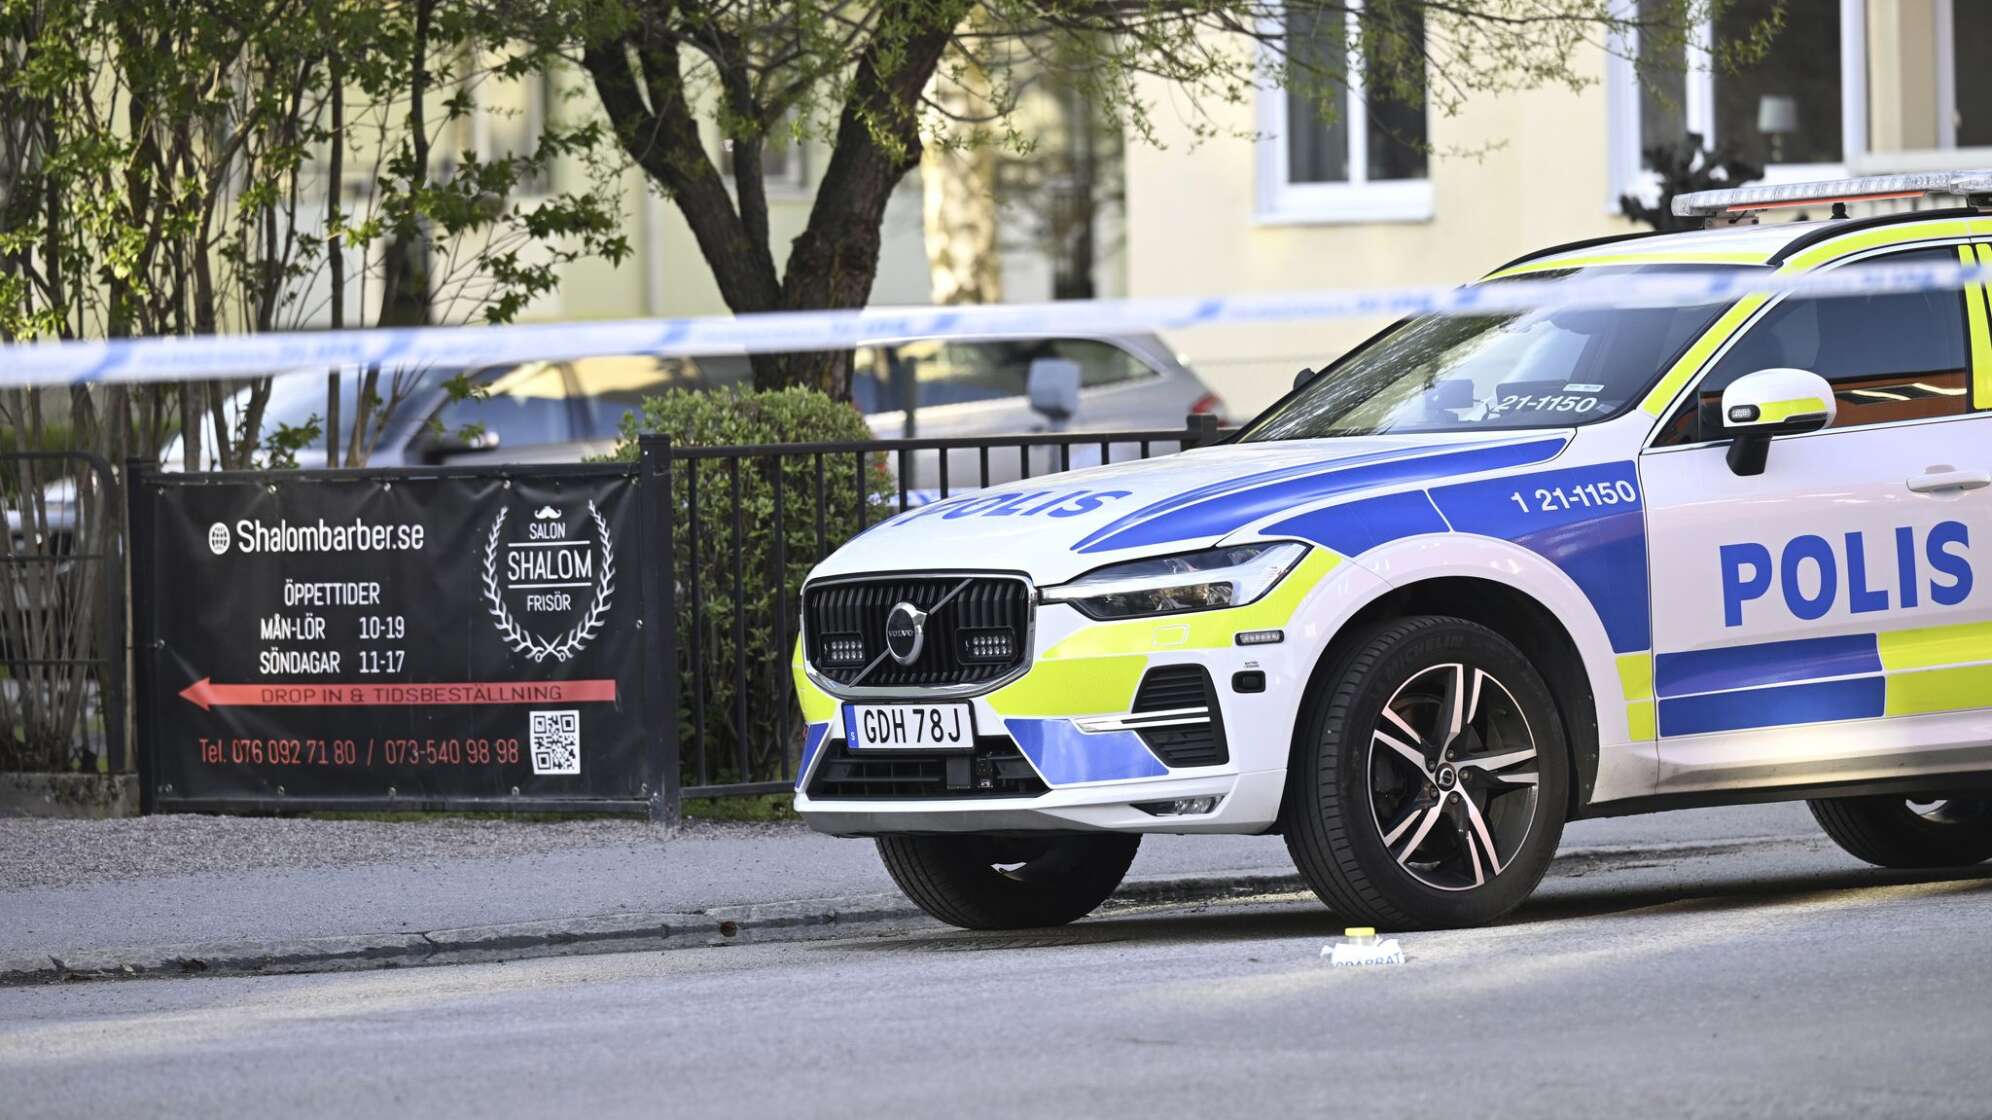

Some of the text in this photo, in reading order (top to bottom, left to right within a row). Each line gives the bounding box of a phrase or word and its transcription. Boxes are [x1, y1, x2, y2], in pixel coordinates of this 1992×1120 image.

[1493, 394, 1598, 414] 21-1150
[891, 489, 1134, 527] POLIS
[1510, 479, 1637, 513] 1 21-1150
[235, 517, 425, 553] Shalombarber.se
[529, 522, 566, 539] SALON
[507, 549, 592, 580] SHALOM
[1719, 520, 1974, 627] POLIS
[284, 578, 381, 606] ÖPPETTIDER
[526, 591, 571, 612] FRISÖR
[260, 613, 405, 640] MÅN-LÖR 10-19
[888, 629, 914, 638] VOLVO
[259, 646, 406, 674] SÖNDAGAR 11-17
[260, 683, 562, 703] DROP IN & TIDSBESTÄLLNING
[863, 707, 961, 743] GDH 78J
[199, 738, 519, 766] Tel. 076 092 71 80 / 073-540 98 98
